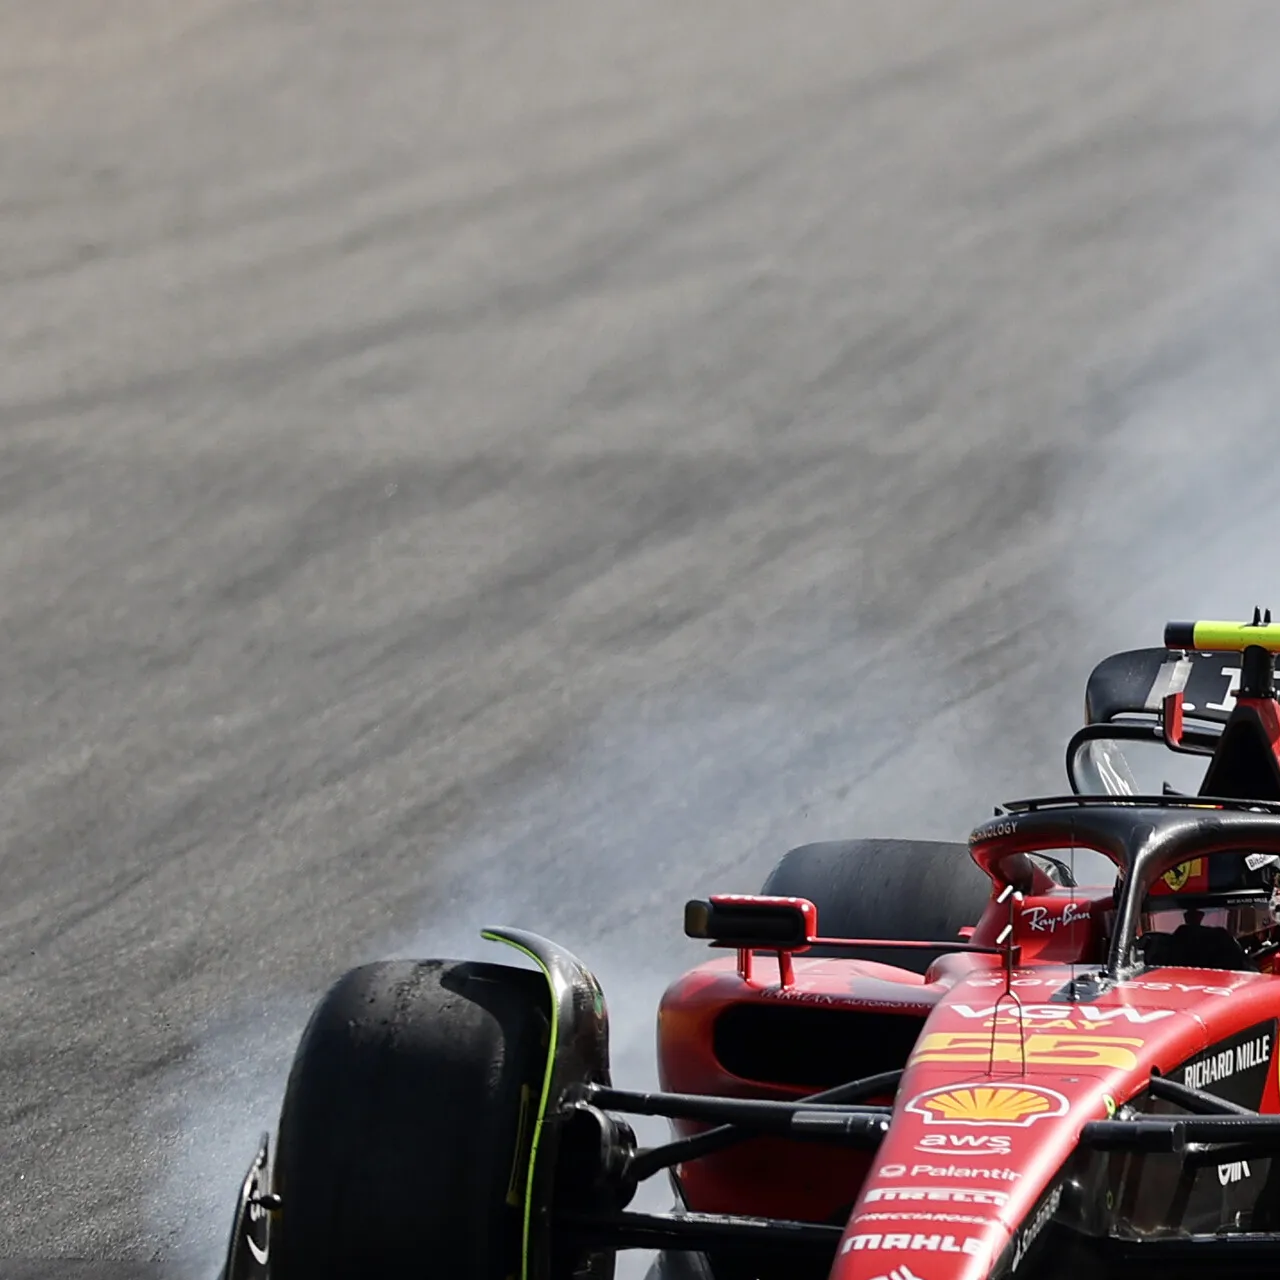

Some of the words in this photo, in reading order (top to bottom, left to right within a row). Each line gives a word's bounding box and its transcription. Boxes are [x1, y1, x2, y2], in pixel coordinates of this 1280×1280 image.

[1021, 904, 1091, 933] Ray-Ban
[950, 1003, 1175, 1023] VGW
[983, 1017, 1113, 1031] PLAY
[910, 1032, 1145, 1070] 55
[1184, 1049, 1234, 1089] RICHARD
[1236, 1034, 1270, 1073] MILLE
[920, 1134, 1012, 1147] aws
[911, 1165, 1024, 1182] Palantir
[864, 1188, 1011, 1206] PIRELLI
